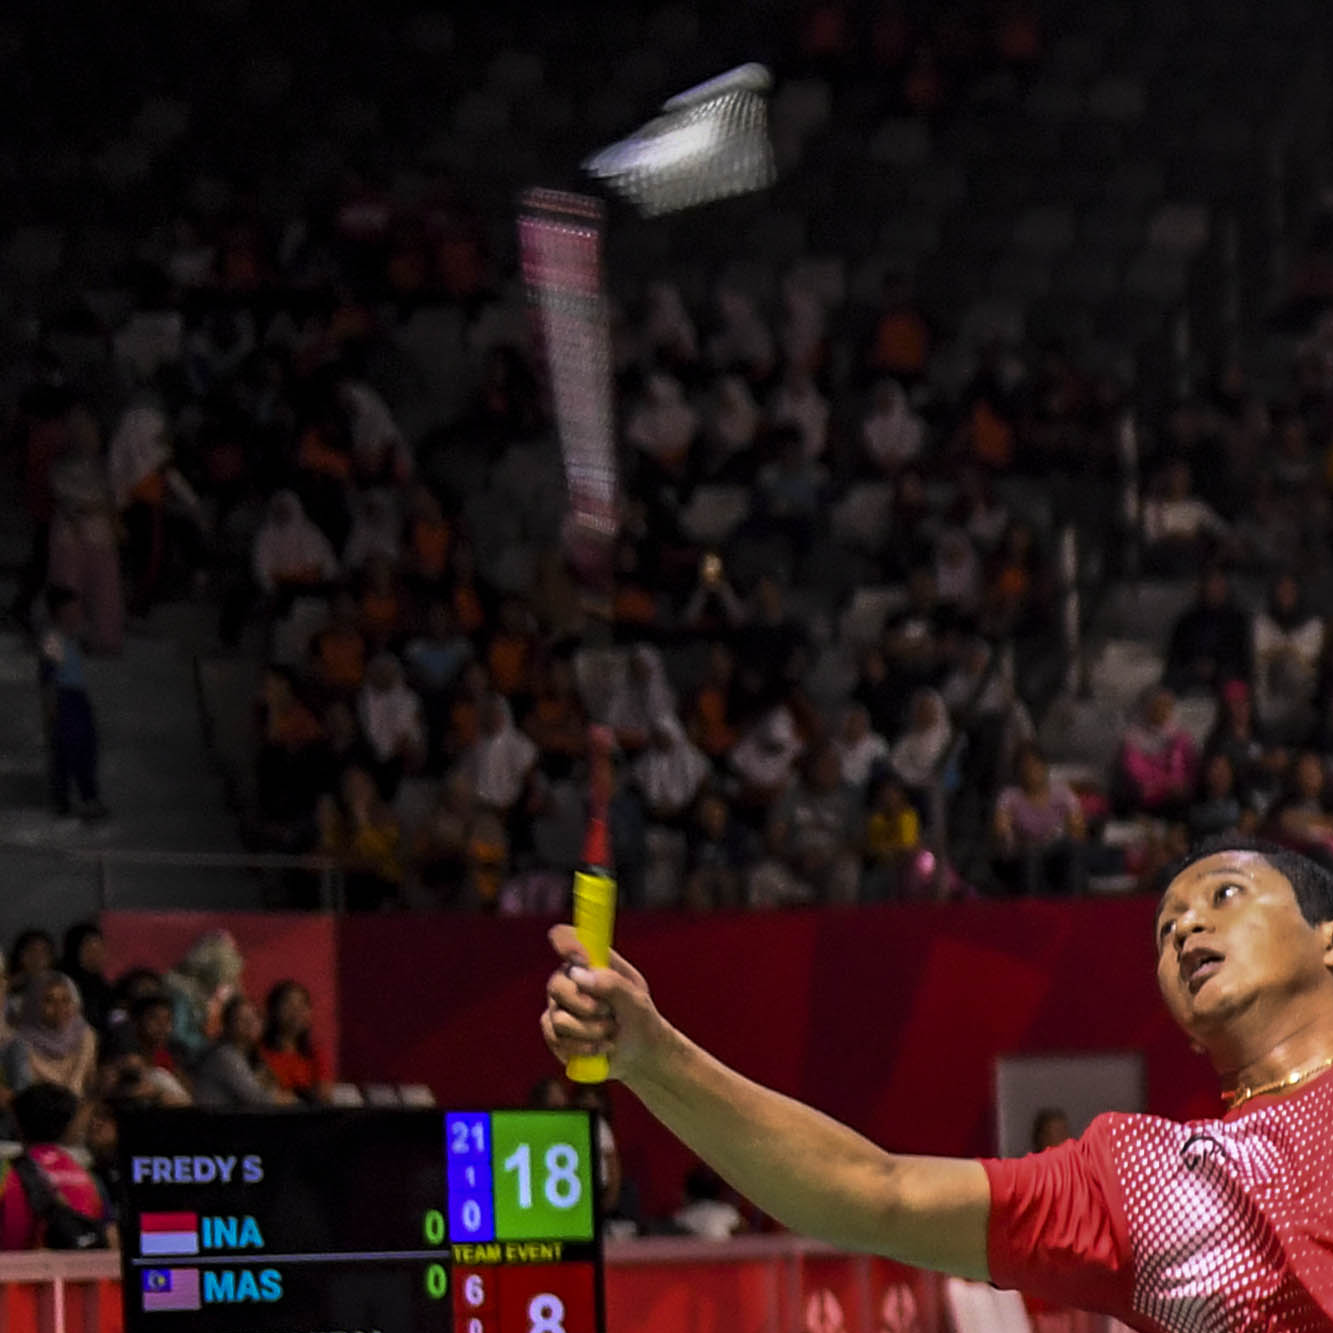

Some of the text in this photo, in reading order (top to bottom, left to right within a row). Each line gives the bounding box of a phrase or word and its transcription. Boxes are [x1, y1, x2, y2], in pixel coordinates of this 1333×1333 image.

[452, 1121, 485, 1154] 21
[131, 1154, 264, 1183] FREDY S
[504, 1143, 582, 1209] 18
[201, 1209, 445, 1248] INA 0
[462, 1199, 481, 1232] 0
[453, 1242, 562, 1264] TEAM EVENT
[203, 1263, 447, 1302] MAS 0
[464, 1273, 484, 1307] 6
